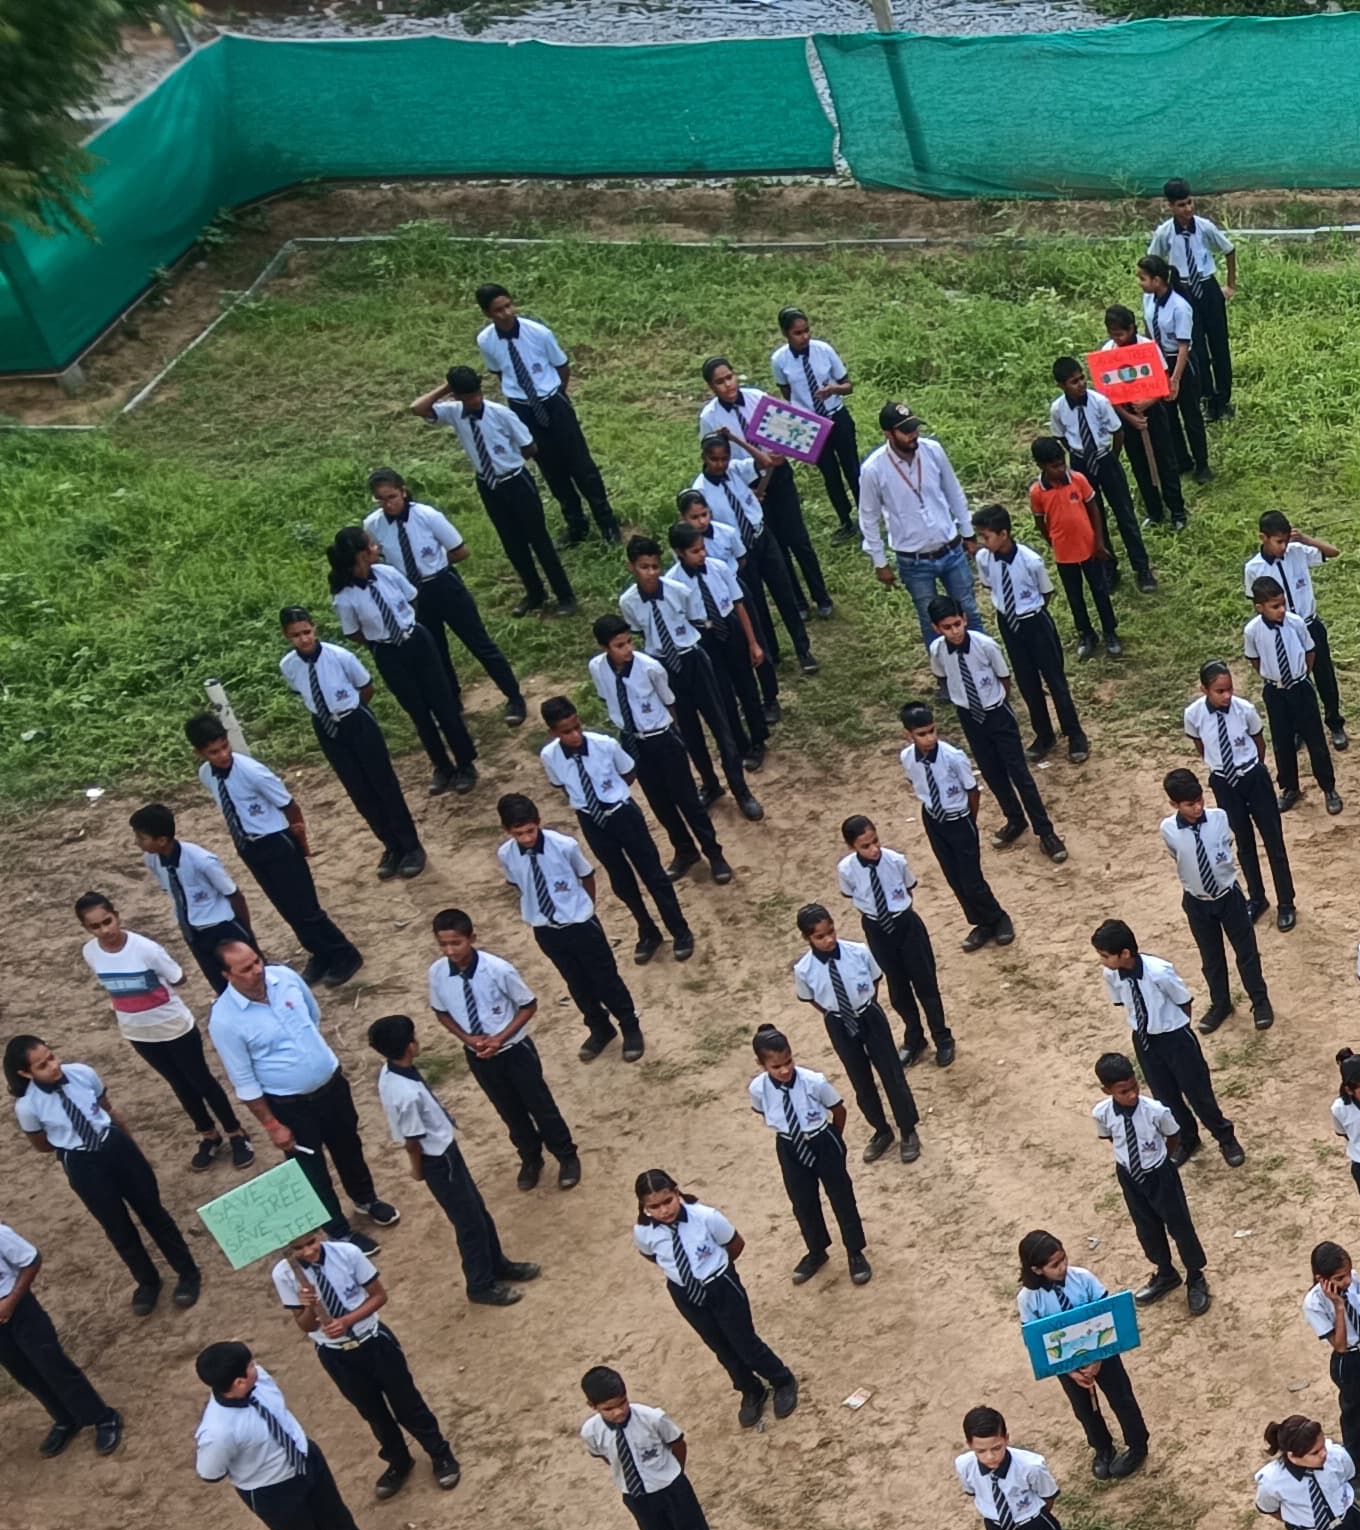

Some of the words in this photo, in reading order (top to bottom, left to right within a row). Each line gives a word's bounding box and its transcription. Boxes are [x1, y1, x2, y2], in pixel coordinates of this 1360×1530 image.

[206, 1182, 263, 1225] SAVE
[256, 1180, 306, 1217] TREE
[225, 1220, 274, 1254] SAVE
[273, 1211, 321, 1245] LIFE
